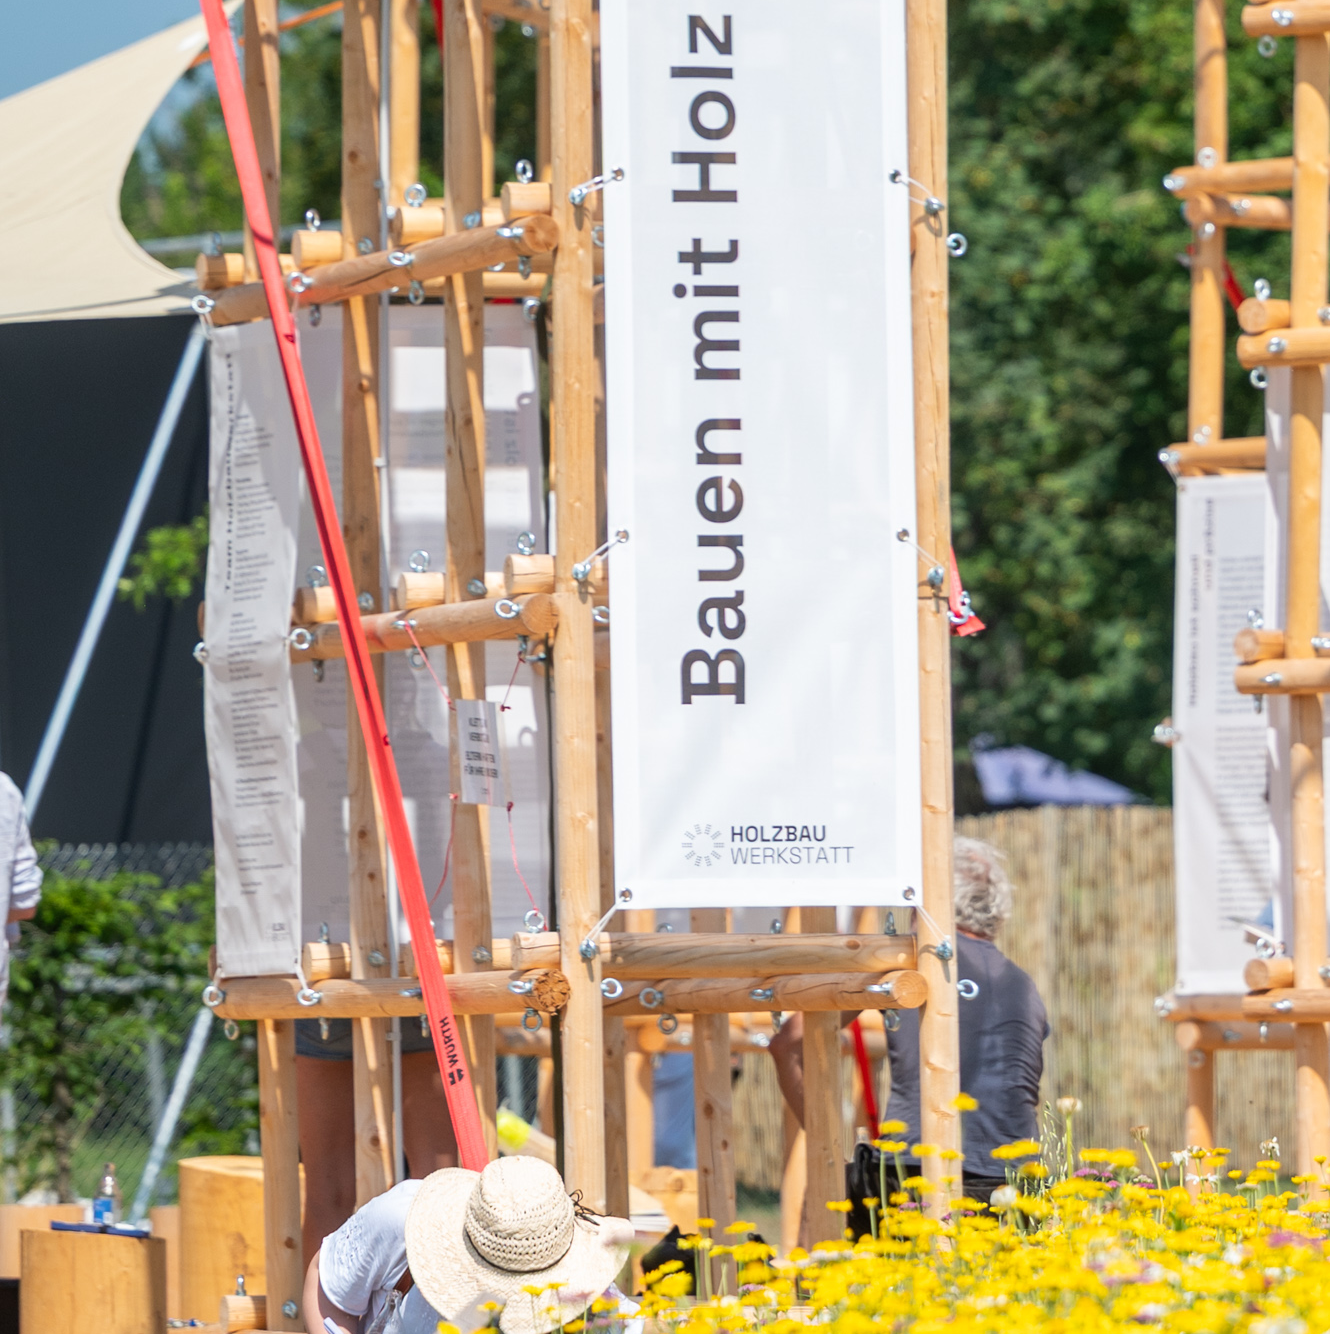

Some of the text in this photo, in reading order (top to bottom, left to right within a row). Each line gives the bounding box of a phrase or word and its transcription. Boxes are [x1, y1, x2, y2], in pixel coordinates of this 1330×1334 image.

[669, 13, 739, 204] Holz
[672, 237, 742, 381] mit
[680, 417, 747, 706] Bauen
[730, 824, 827, 843] HOLZBAU
[730, 846, 855, 865] WERKSTATT
